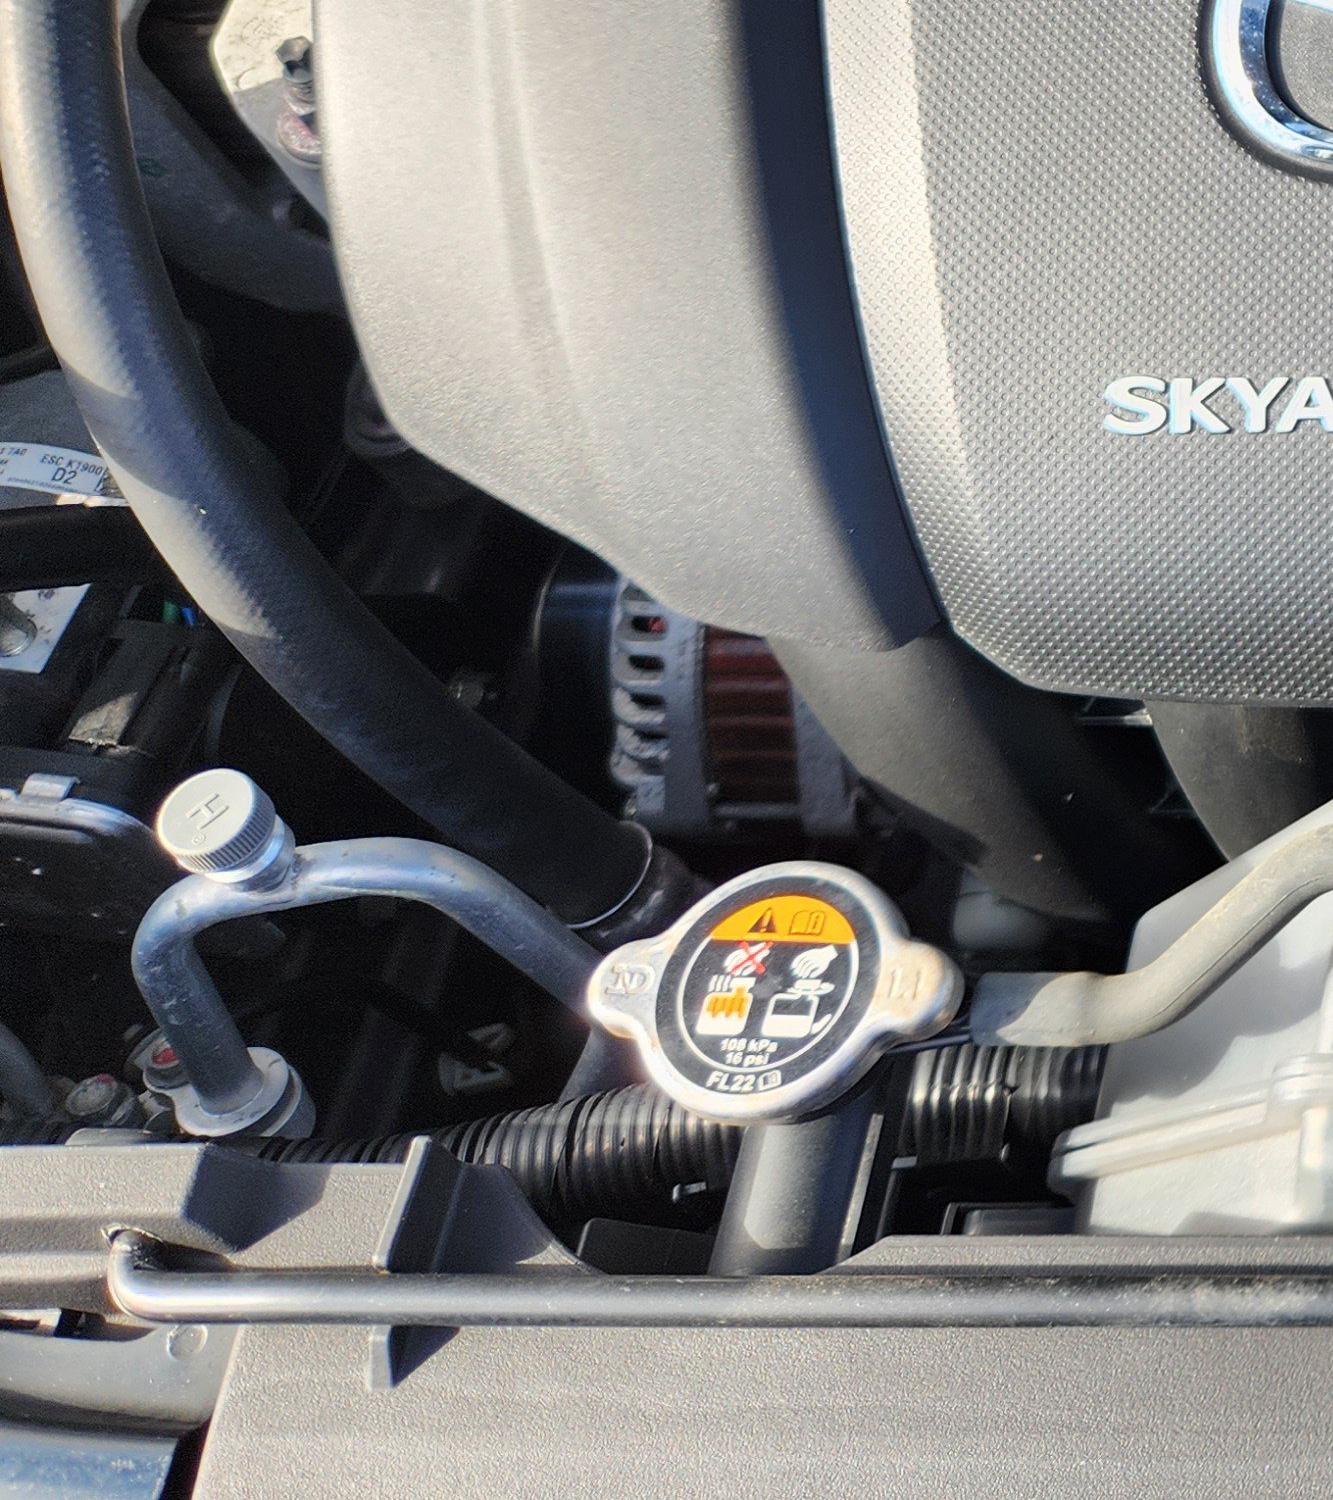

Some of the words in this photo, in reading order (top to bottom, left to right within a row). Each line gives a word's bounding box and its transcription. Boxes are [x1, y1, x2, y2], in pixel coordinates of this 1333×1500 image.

[40, 454, 64, 467] ESC
[51, 467, 78, 485] D2
[187, 793, 230, 831] H
[721, 1038, 748, 1052] 108
[748, 1037, 778, 1053] kPa
[726, 1053, 743, 1065] 16
[744, 1052, 770, 1067] psi
[706, 1075, 756, 1092] FL22
